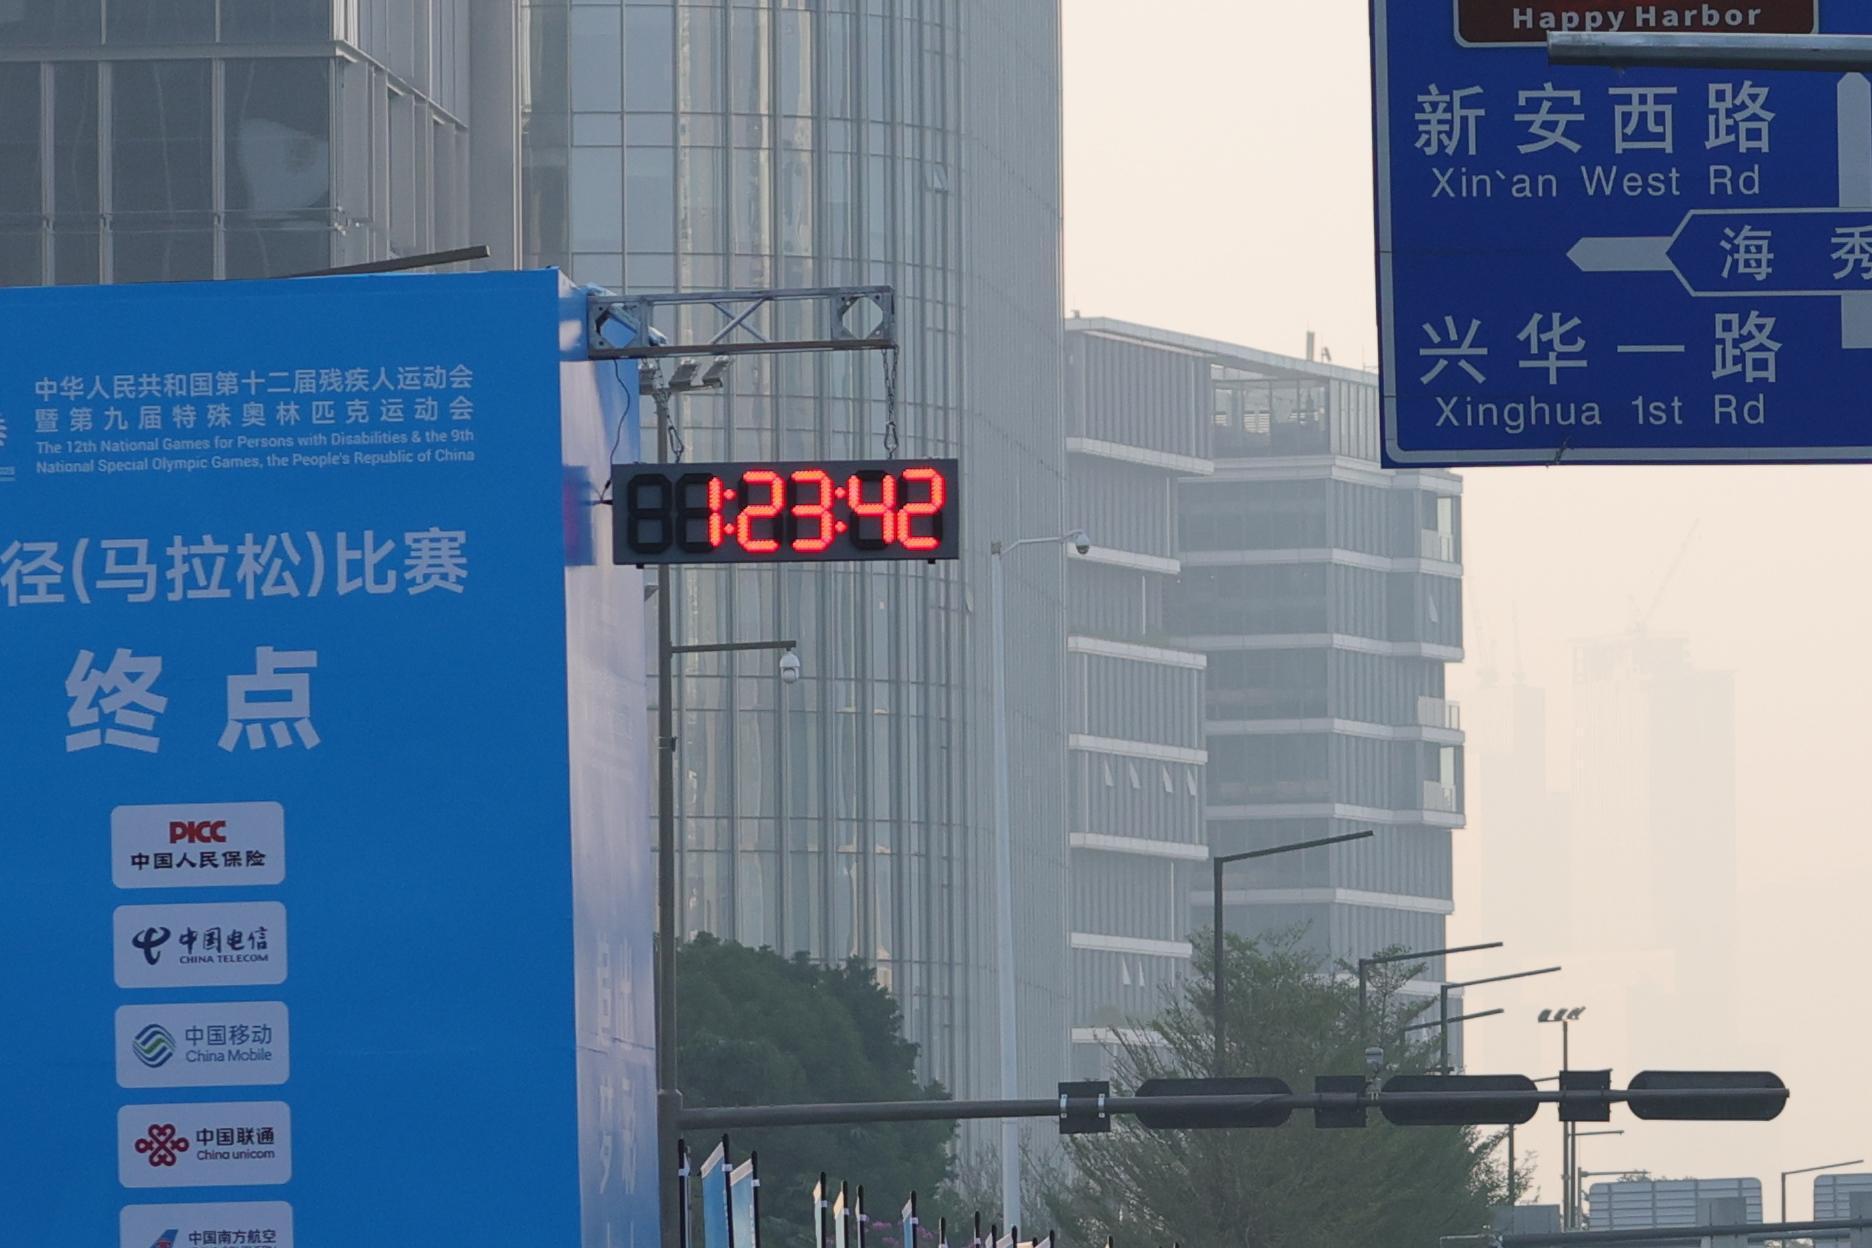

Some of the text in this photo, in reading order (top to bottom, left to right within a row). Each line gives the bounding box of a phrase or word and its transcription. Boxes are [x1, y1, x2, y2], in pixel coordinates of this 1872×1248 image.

[1513, 5, 1762, 33] Happy Harbor
[1414, 80, 1775, 155] 新安西路
[1581, 166, 1680, 196] West
[1709, 164, 1760, 195] Rd
[1419, 311, 1782, 384] 兴华一路
[34, 364, 474, 401] 中华人民共和国第十二届残疾人运动会
[34, 395, 475, 433] 暨第九届特殊奥林匹克运动会
[1436, 394, 1765, 434] Xinghua 1st Rd
[36, 431, 474, 454] The 12th National Games for Persons with Disabilities & the 9th
[36, 449, 475, 475] National Special Olympic Games, the People's Republic of China
[708, 466, 947, 553] 1:23:42
[0, 528, 468, 607] 径(马拉松)比赛
[64, 646, 321, 753] 终点
[169, 821, 226, 843] PICC
[131, 851, 266, 871] 中国人民保险
[178, 926, 268, 954] 中国电信
[179, 953, 268, 964] CHINA TELECOM
[185, 1024, 272, 1047] 中国移动
[185, 1049, 272, 1064] China Mobile
[196, 1128, 274, 1146] 中国联通
[197, 1150, 275, 1161] China unicom
[188, 1230, 276, 1245] 中国南方航空
